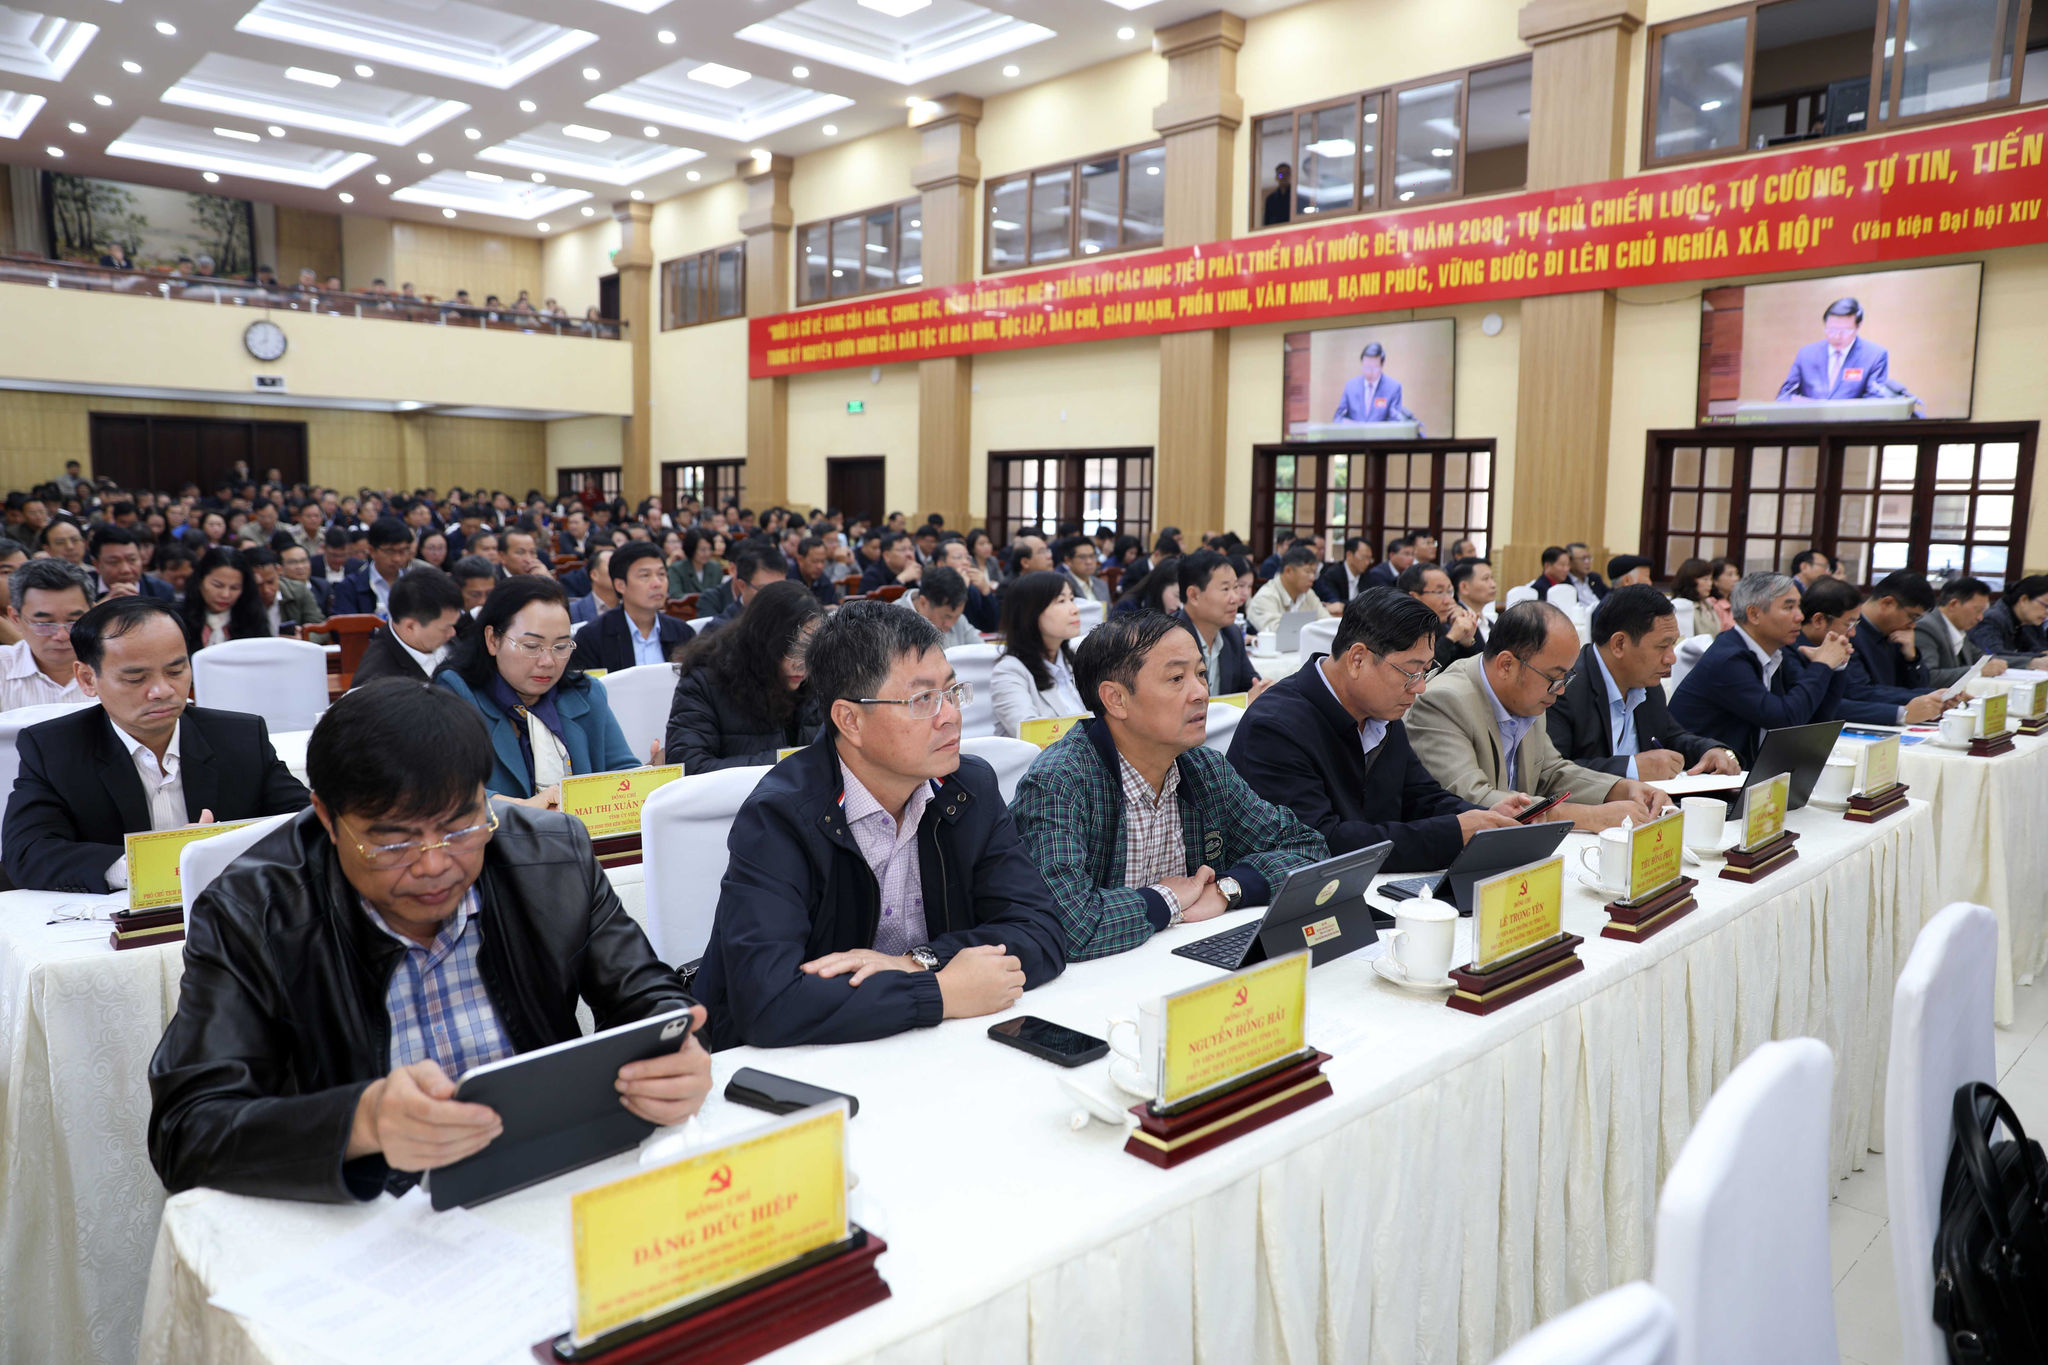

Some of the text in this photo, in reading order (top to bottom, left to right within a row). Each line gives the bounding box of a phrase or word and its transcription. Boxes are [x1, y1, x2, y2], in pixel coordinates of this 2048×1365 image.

[1094, 271, 1114, 298] LỢI
[1115, 267, 1141, 292] CÁC
[1142, 265, 1172, 291] MỤC
[1175, 257, 1205, 286] TIÊU
[1208, 250, 1244, 279] PHÁT
[1247, 240, 1290, 274] TRIỂN
[1293, 236, 1324, 268] ĐẤT
[1327, 231, 1369, 263] NƯỚC
[1374, 224, 1409, 256] ĐẾN
[1412, 221, 1454, 252] NĂM
[1458, 215, 1511, 246] 2030;
[1517, 206, 1542, 241] TỰ
[1546, 197, 1586, 234] CHỦ
[1590, 188, 1654, 228] CHIẾN
[1659, 182, 1722, 221] LƯỢC,
[1728, 174, 1759, 213] TỰ
[1763, 165, 1854, 205] CƯỜNG,
[1863, 153, 1899, 195] TỰ
[1905, 149, 1958, 185] TIN,
[1971, 127, 2044, 175] TIẾN
[1103, 303, 1132, 327] GIÀU
[1134, 299, 1175, 325] MẠNH,
[1217, 288, 1252, 313] VINH,
[1256, 281, 1286, 308] VĂN
[1290, 279, 1333, 304] MINH,
[1338, 274, 1381, 302] HẠNH
[1385, 263, 1433, 294] PHÚC,
[1438, 257, 1485, 288] VỮNG
[1489, 249, 1539, 283] BƯỚC
[1543, 249, 1564, 277] ĐI
[1569, 241, 1609, 275] LÊN
[1615, 231, 1657, 270] CHỦ
[1662, 226, 1729, 264] NGHĨA
[1736, 220, 1770, 256] XÃ
[1777, 214, 1834, 255] HỘI"
[1852, 221, 1892, 245] (Văn
[1896, 215, 1933, 239] kiện
[1939, 210, 1969, 234] Đại
[1973, 204, 2004, 230] hội
[2008, 199, 2042, 223] XIV
[574, 806, 593, 816] MAI
[594, 803, 611, 814] THỊ
[613, 800, 639, 811] XUÂN
